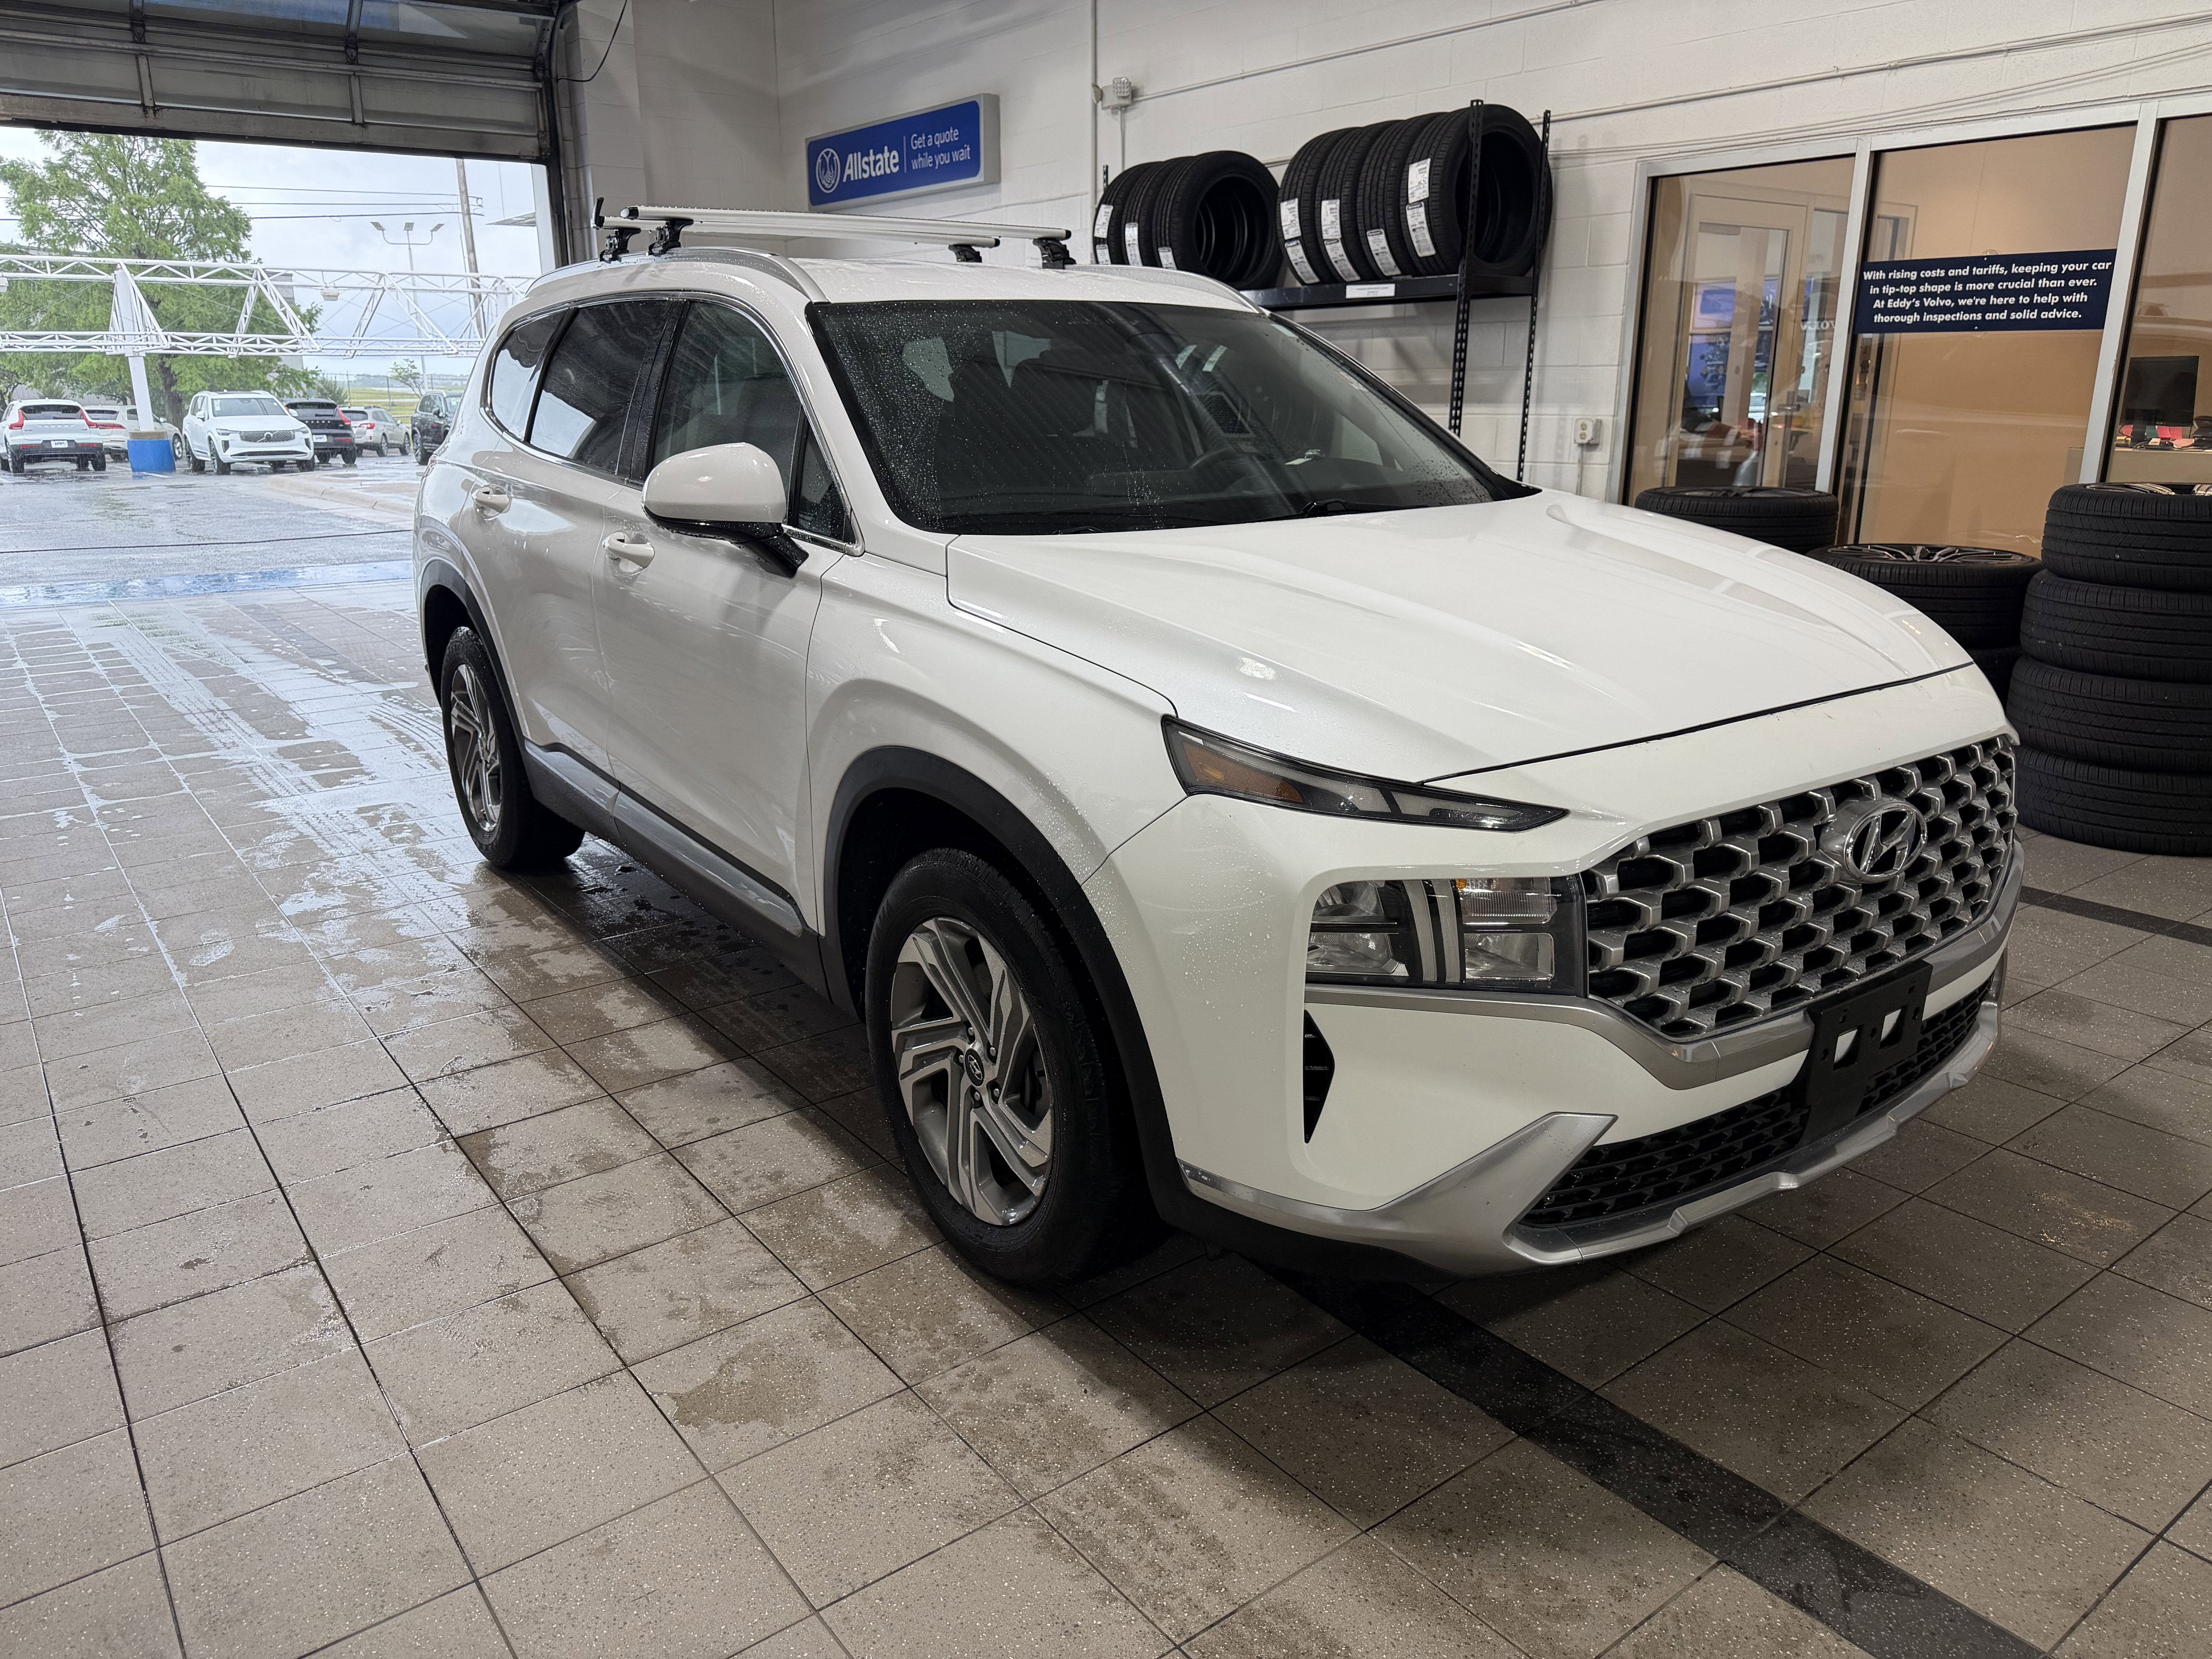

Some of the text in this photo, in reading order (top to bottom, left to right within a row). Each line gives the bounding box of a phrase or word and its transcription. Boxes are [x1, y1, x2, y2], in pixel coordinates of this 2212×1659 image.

[910, 127, 959, 150] Get a quote
[843, 146, 900, 182] Allstate
[911, 144, 971, 170] while you wait
[1863, 262, 2112, 280] With rising costs and tariffs, keeping your car
[1870, 278, 2097, 296] in tip-top shape is more crucial than ever.
[1873, 292, 2088, 309] At Eddy's Volvo, we're here to help with
[1874, 308, 2081, 324] thorough inspections and solid advice.
